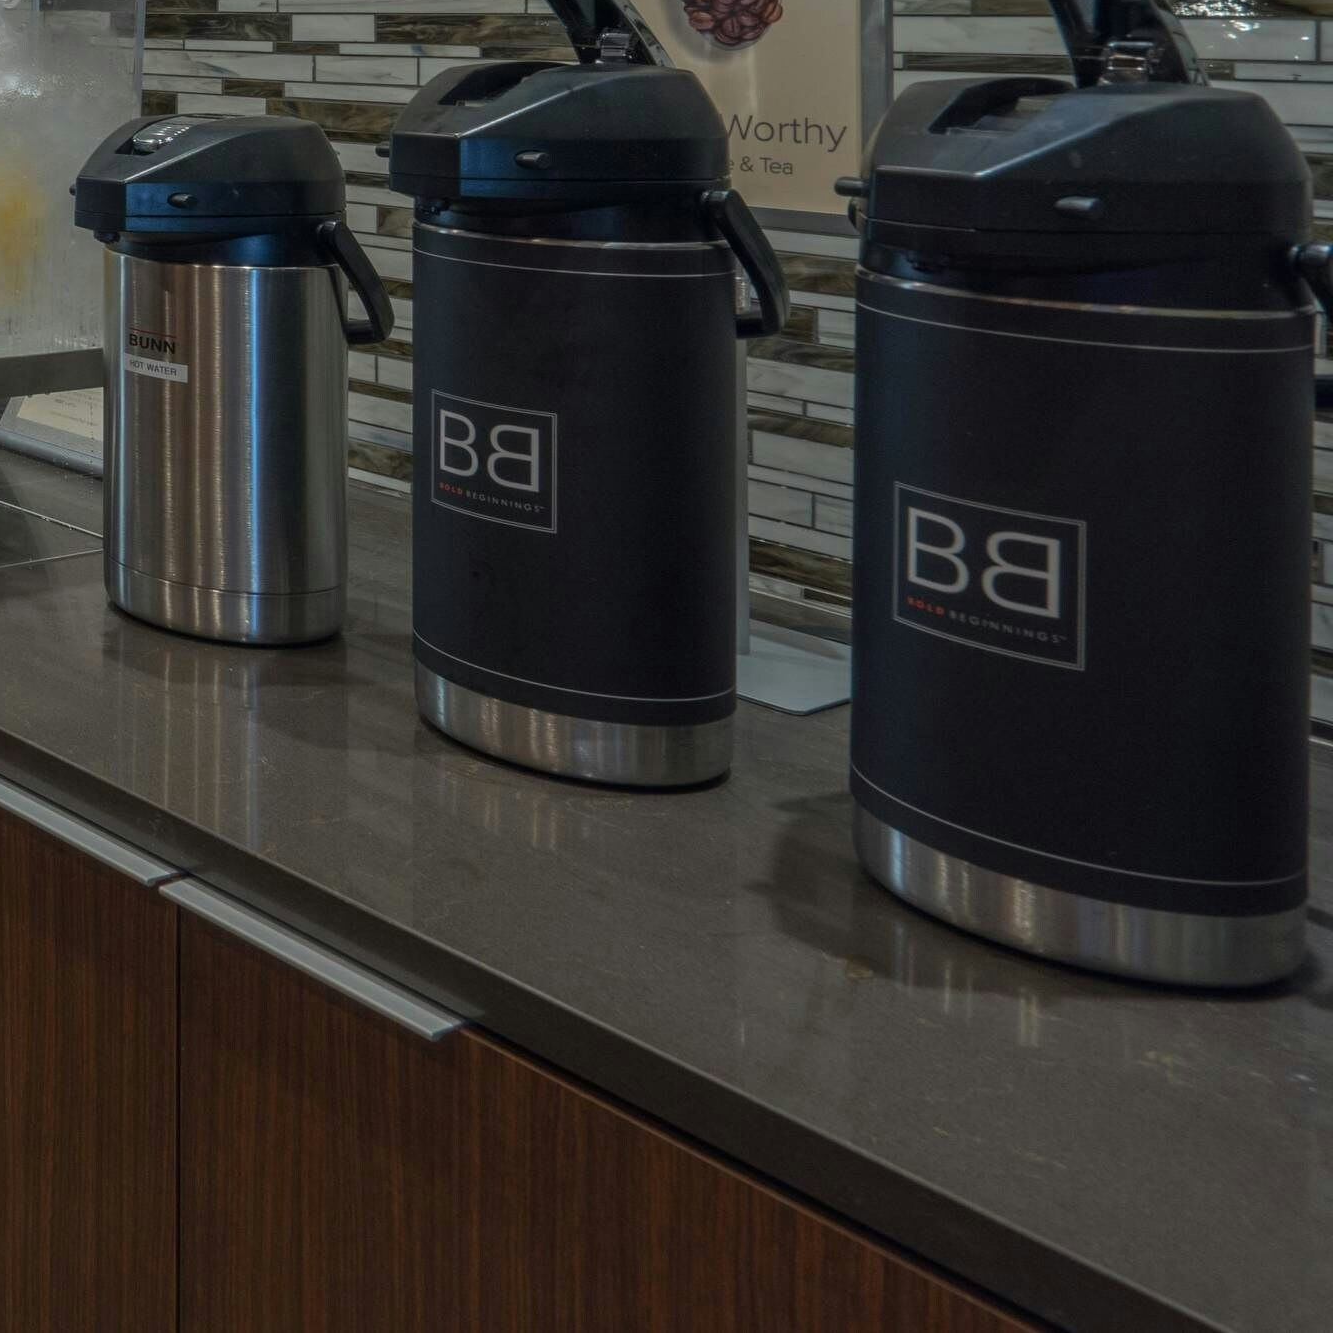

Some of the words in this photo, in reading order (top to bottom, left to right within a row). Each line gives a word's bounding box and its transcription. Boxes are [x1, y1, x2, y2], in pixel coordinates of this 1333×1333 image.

[740, 155, 754, 172] &
[759, 156, 794, 175] Tea
[129, 333, 176, 355] BUNN
[130, 359, 144, 370] HOT
[147, 363, 177, 377] WATER
[439, 481, 464, 496] BOLD
[906, 595, 945, 617] BOLD
